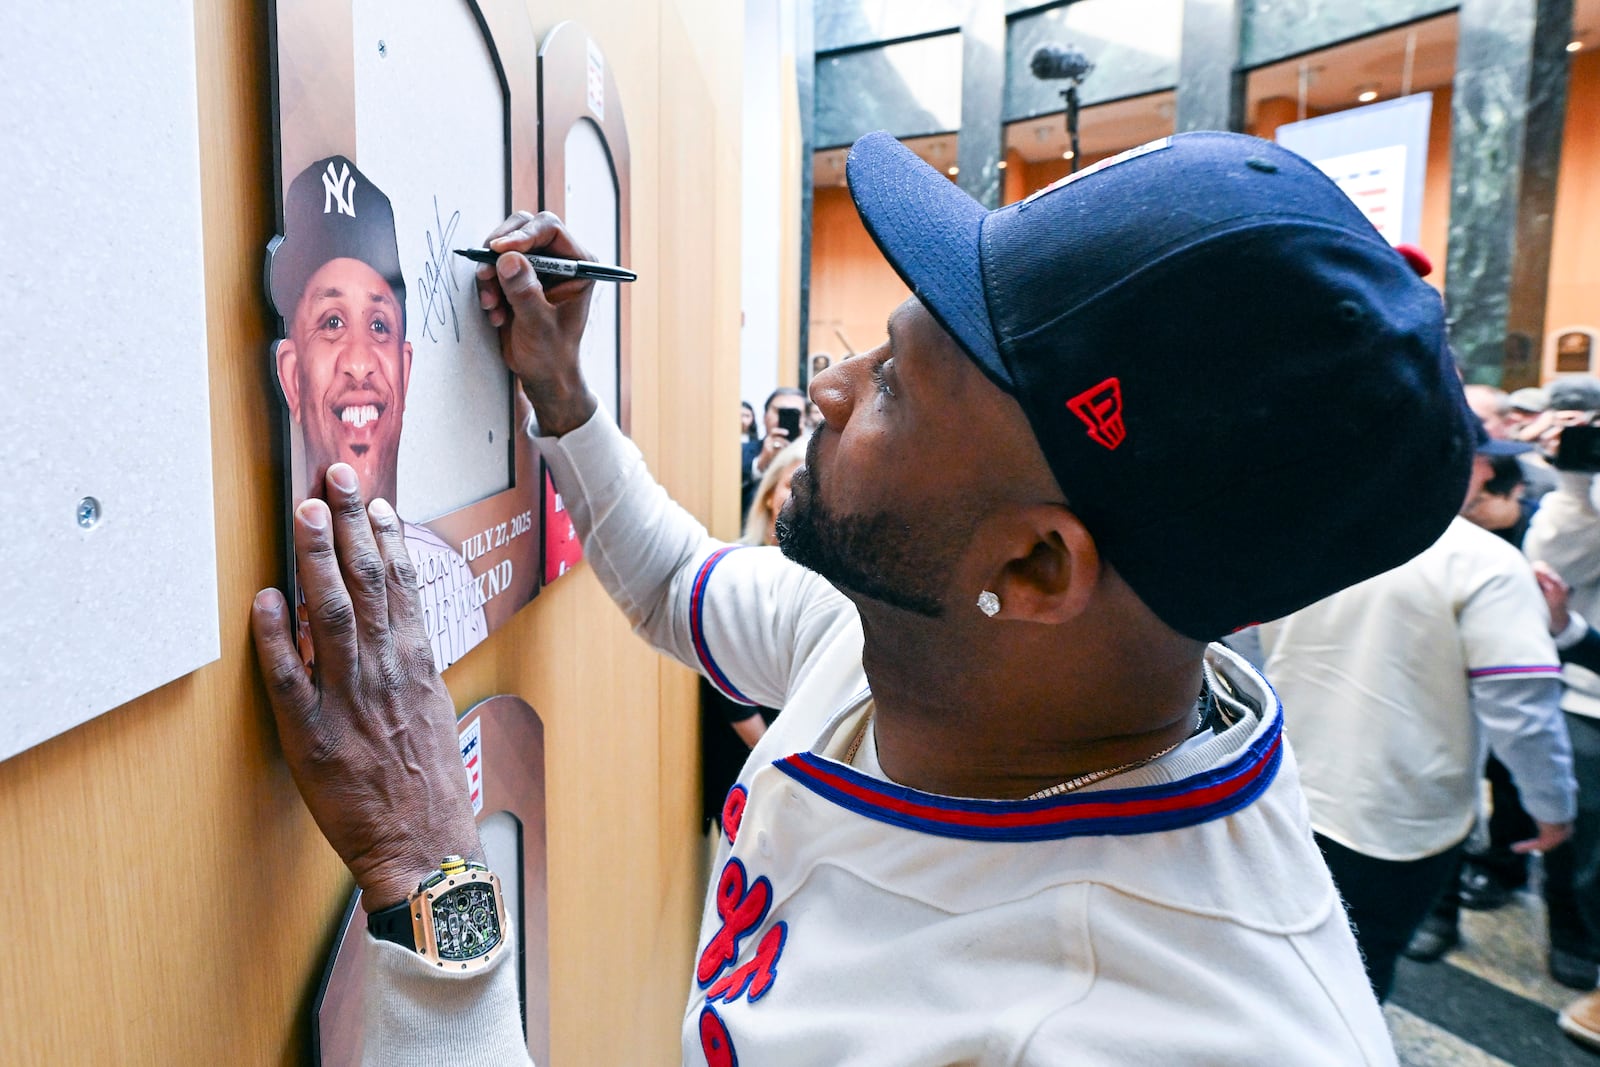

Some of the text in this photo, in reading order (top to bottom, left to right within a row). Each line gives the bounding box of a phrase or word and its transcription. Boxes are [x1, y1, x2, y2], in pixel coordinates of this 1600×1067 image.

[321, 161, 356, 218] NY
[459, 530, 494, 567] JULY
[510, 511, 532, 539] 2025
